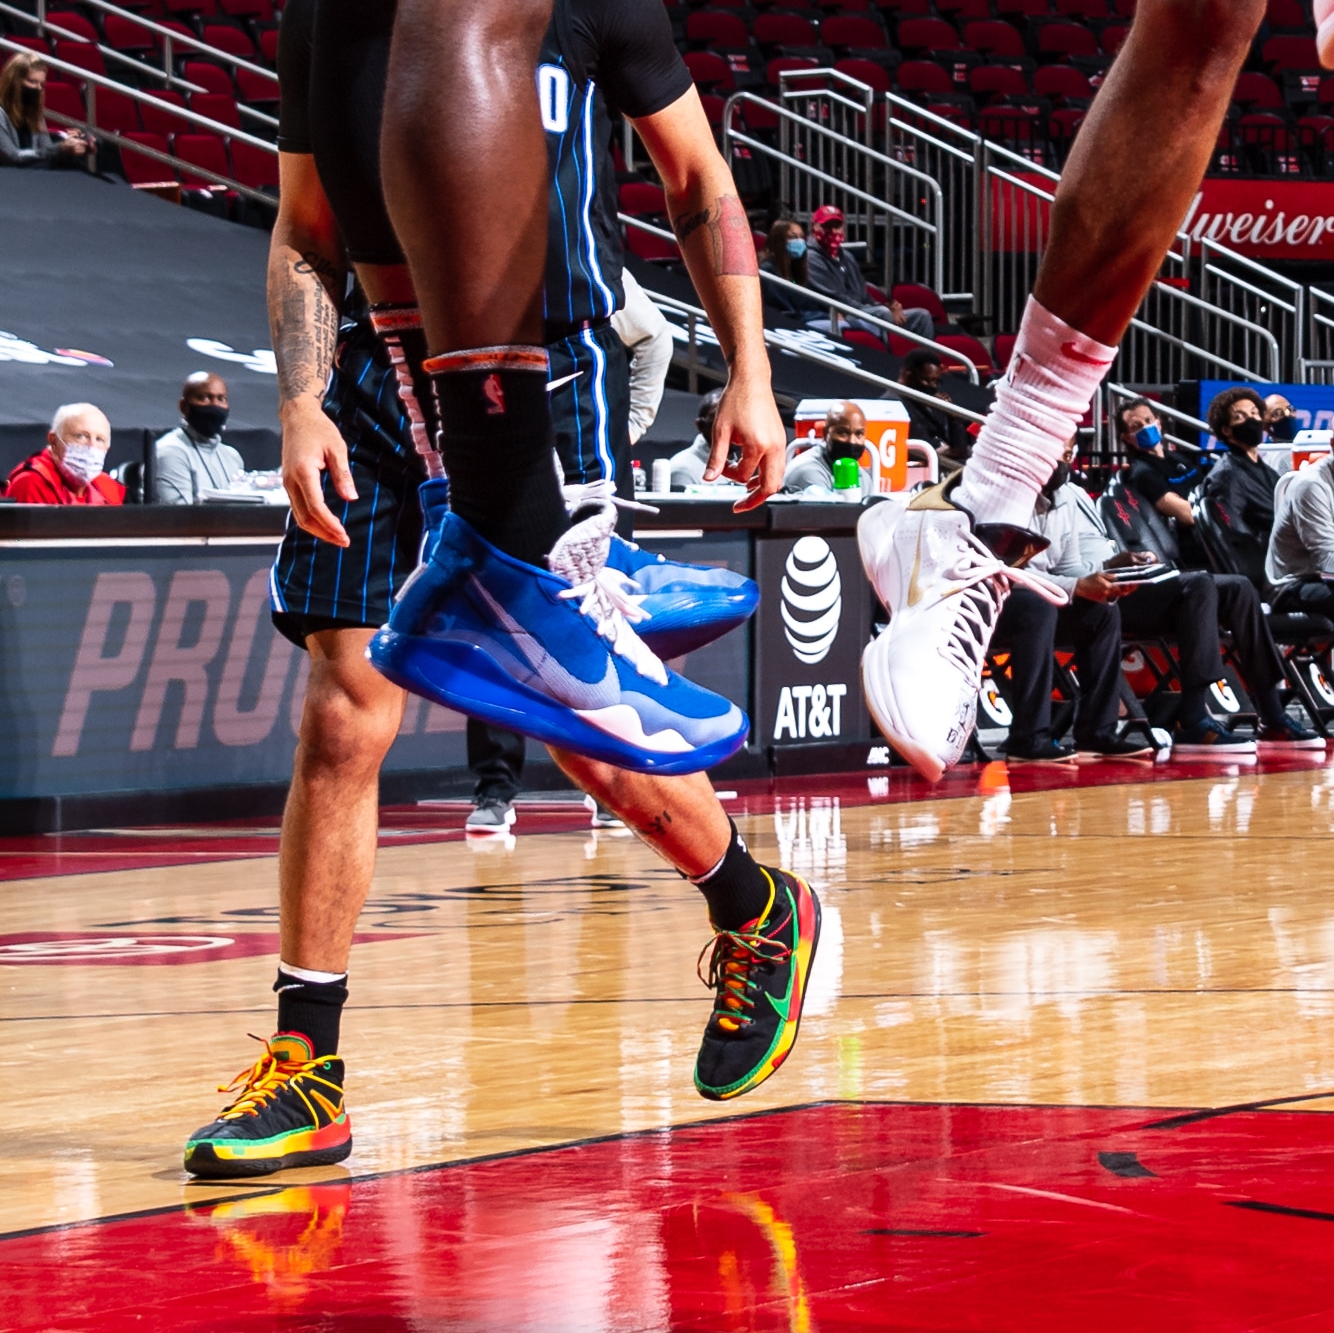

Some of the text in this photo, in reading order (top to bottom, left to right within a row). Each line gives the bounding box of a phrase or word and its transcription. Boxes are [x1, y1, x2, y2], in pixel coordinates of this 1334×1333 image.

[879, 429, 897, 469] G
[52, 569, 308, 758] PRO
[773, 683, 847, 740] AT&T
